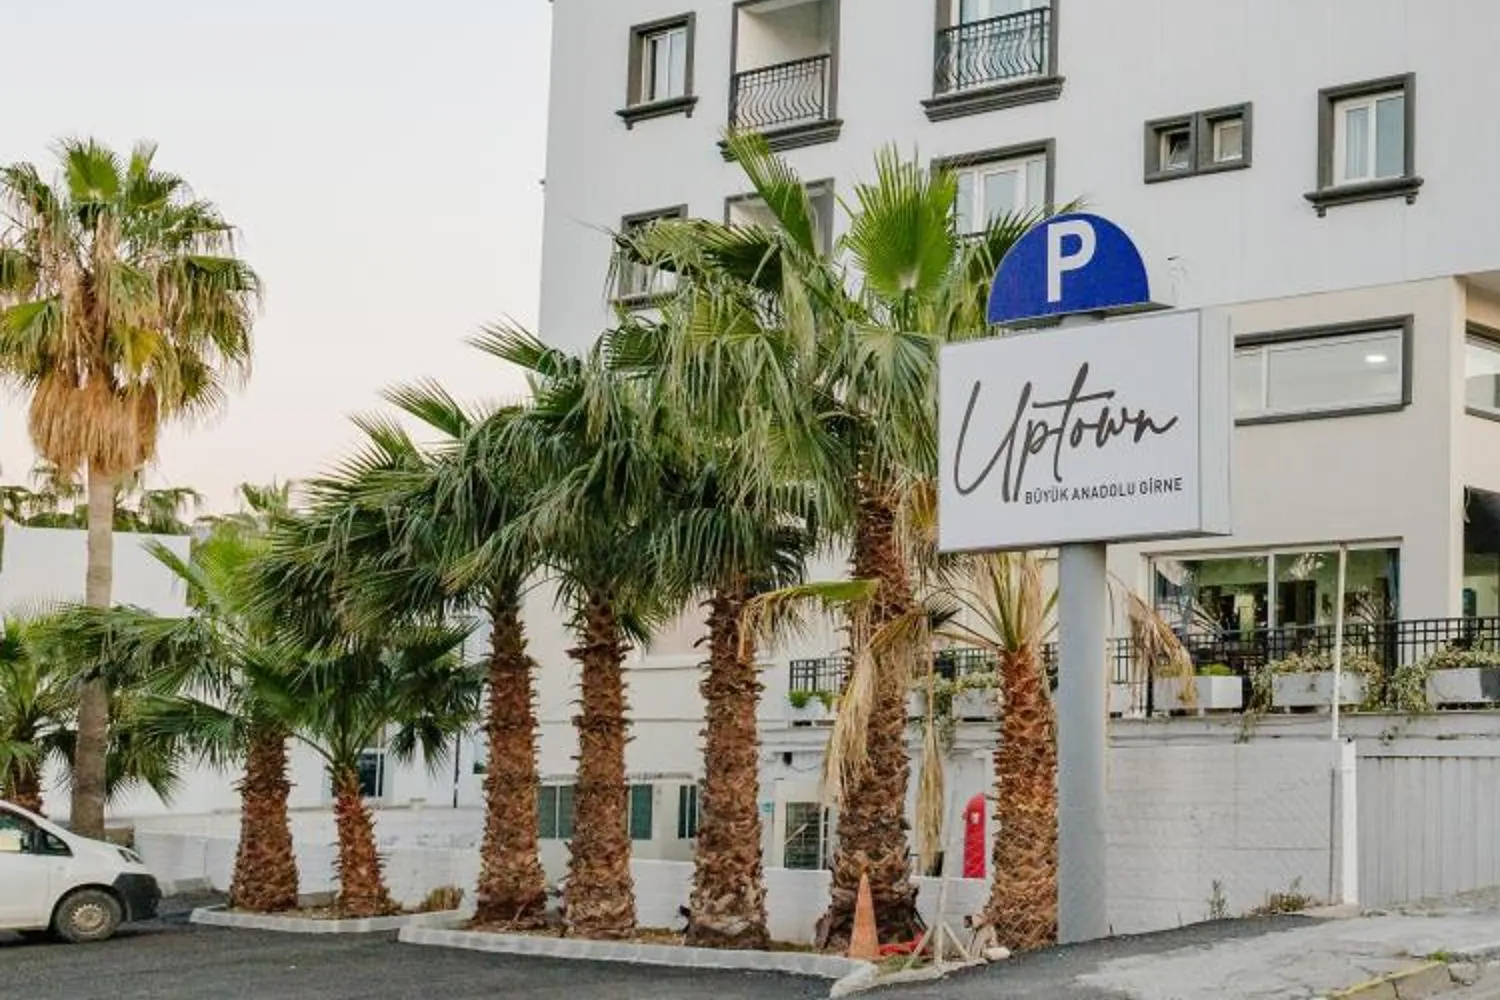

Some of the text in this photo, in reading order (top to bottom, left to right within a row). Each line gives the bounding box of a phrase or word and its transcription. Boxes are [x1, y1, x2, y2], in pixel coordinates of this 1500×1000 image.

[1047, 219, 1097, 303] P
[954, 362, 1178, 502] Uptown
[1025, 477, 1183, 505] BÜYÜK ANADOLU GİRNE
